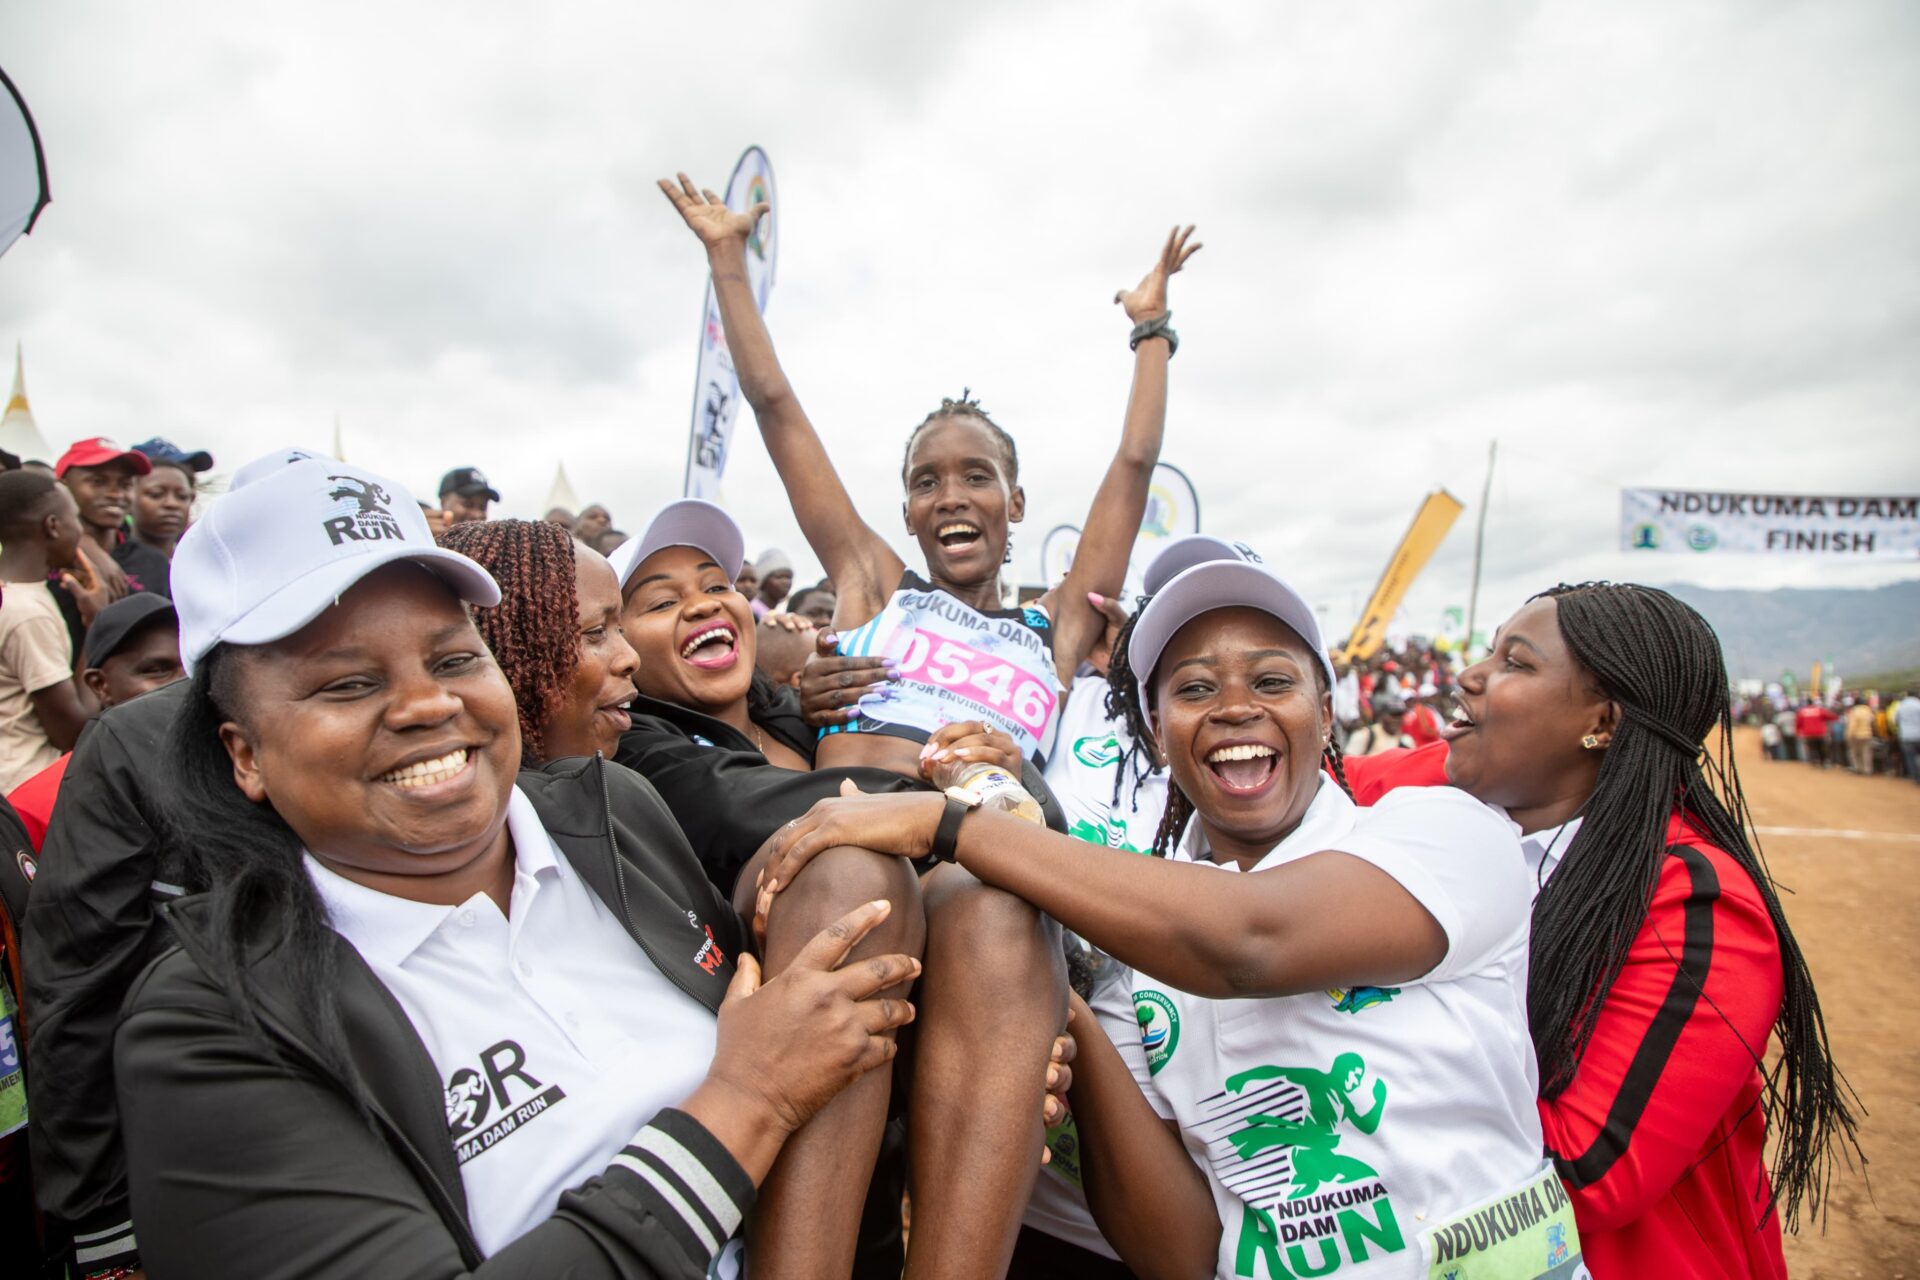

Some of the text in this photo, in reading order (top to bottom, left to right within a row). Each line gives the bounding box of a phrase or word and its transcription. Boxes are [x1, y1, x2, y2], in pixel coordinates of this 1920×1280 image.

[1660, 493, 1918, 519] NDUKUMA DAM
[323, 516, 405, 546] RUN
[1766, 529, 1876, 552] FINISH
[899, 593, 990, 632] UKUMA
[997, 621, 1040, 654] DAM
[902, 631, 1049, 729] 0546
[909, 681, 1028, 740] FOR ENVIRONMENT
[1140, 991, 1177, 1023] CONSERVANCY
[457, 1095, 548, 1161] MA DAM RUN
[1278, 1182, 1388, 1220] NDUKUMA
[1433, 1173, 1570, 1264] NDUKUMA DA
[1235, 1196, 1406, 1280] RUN
[1280, 1215, 1338, 1243] DAM
